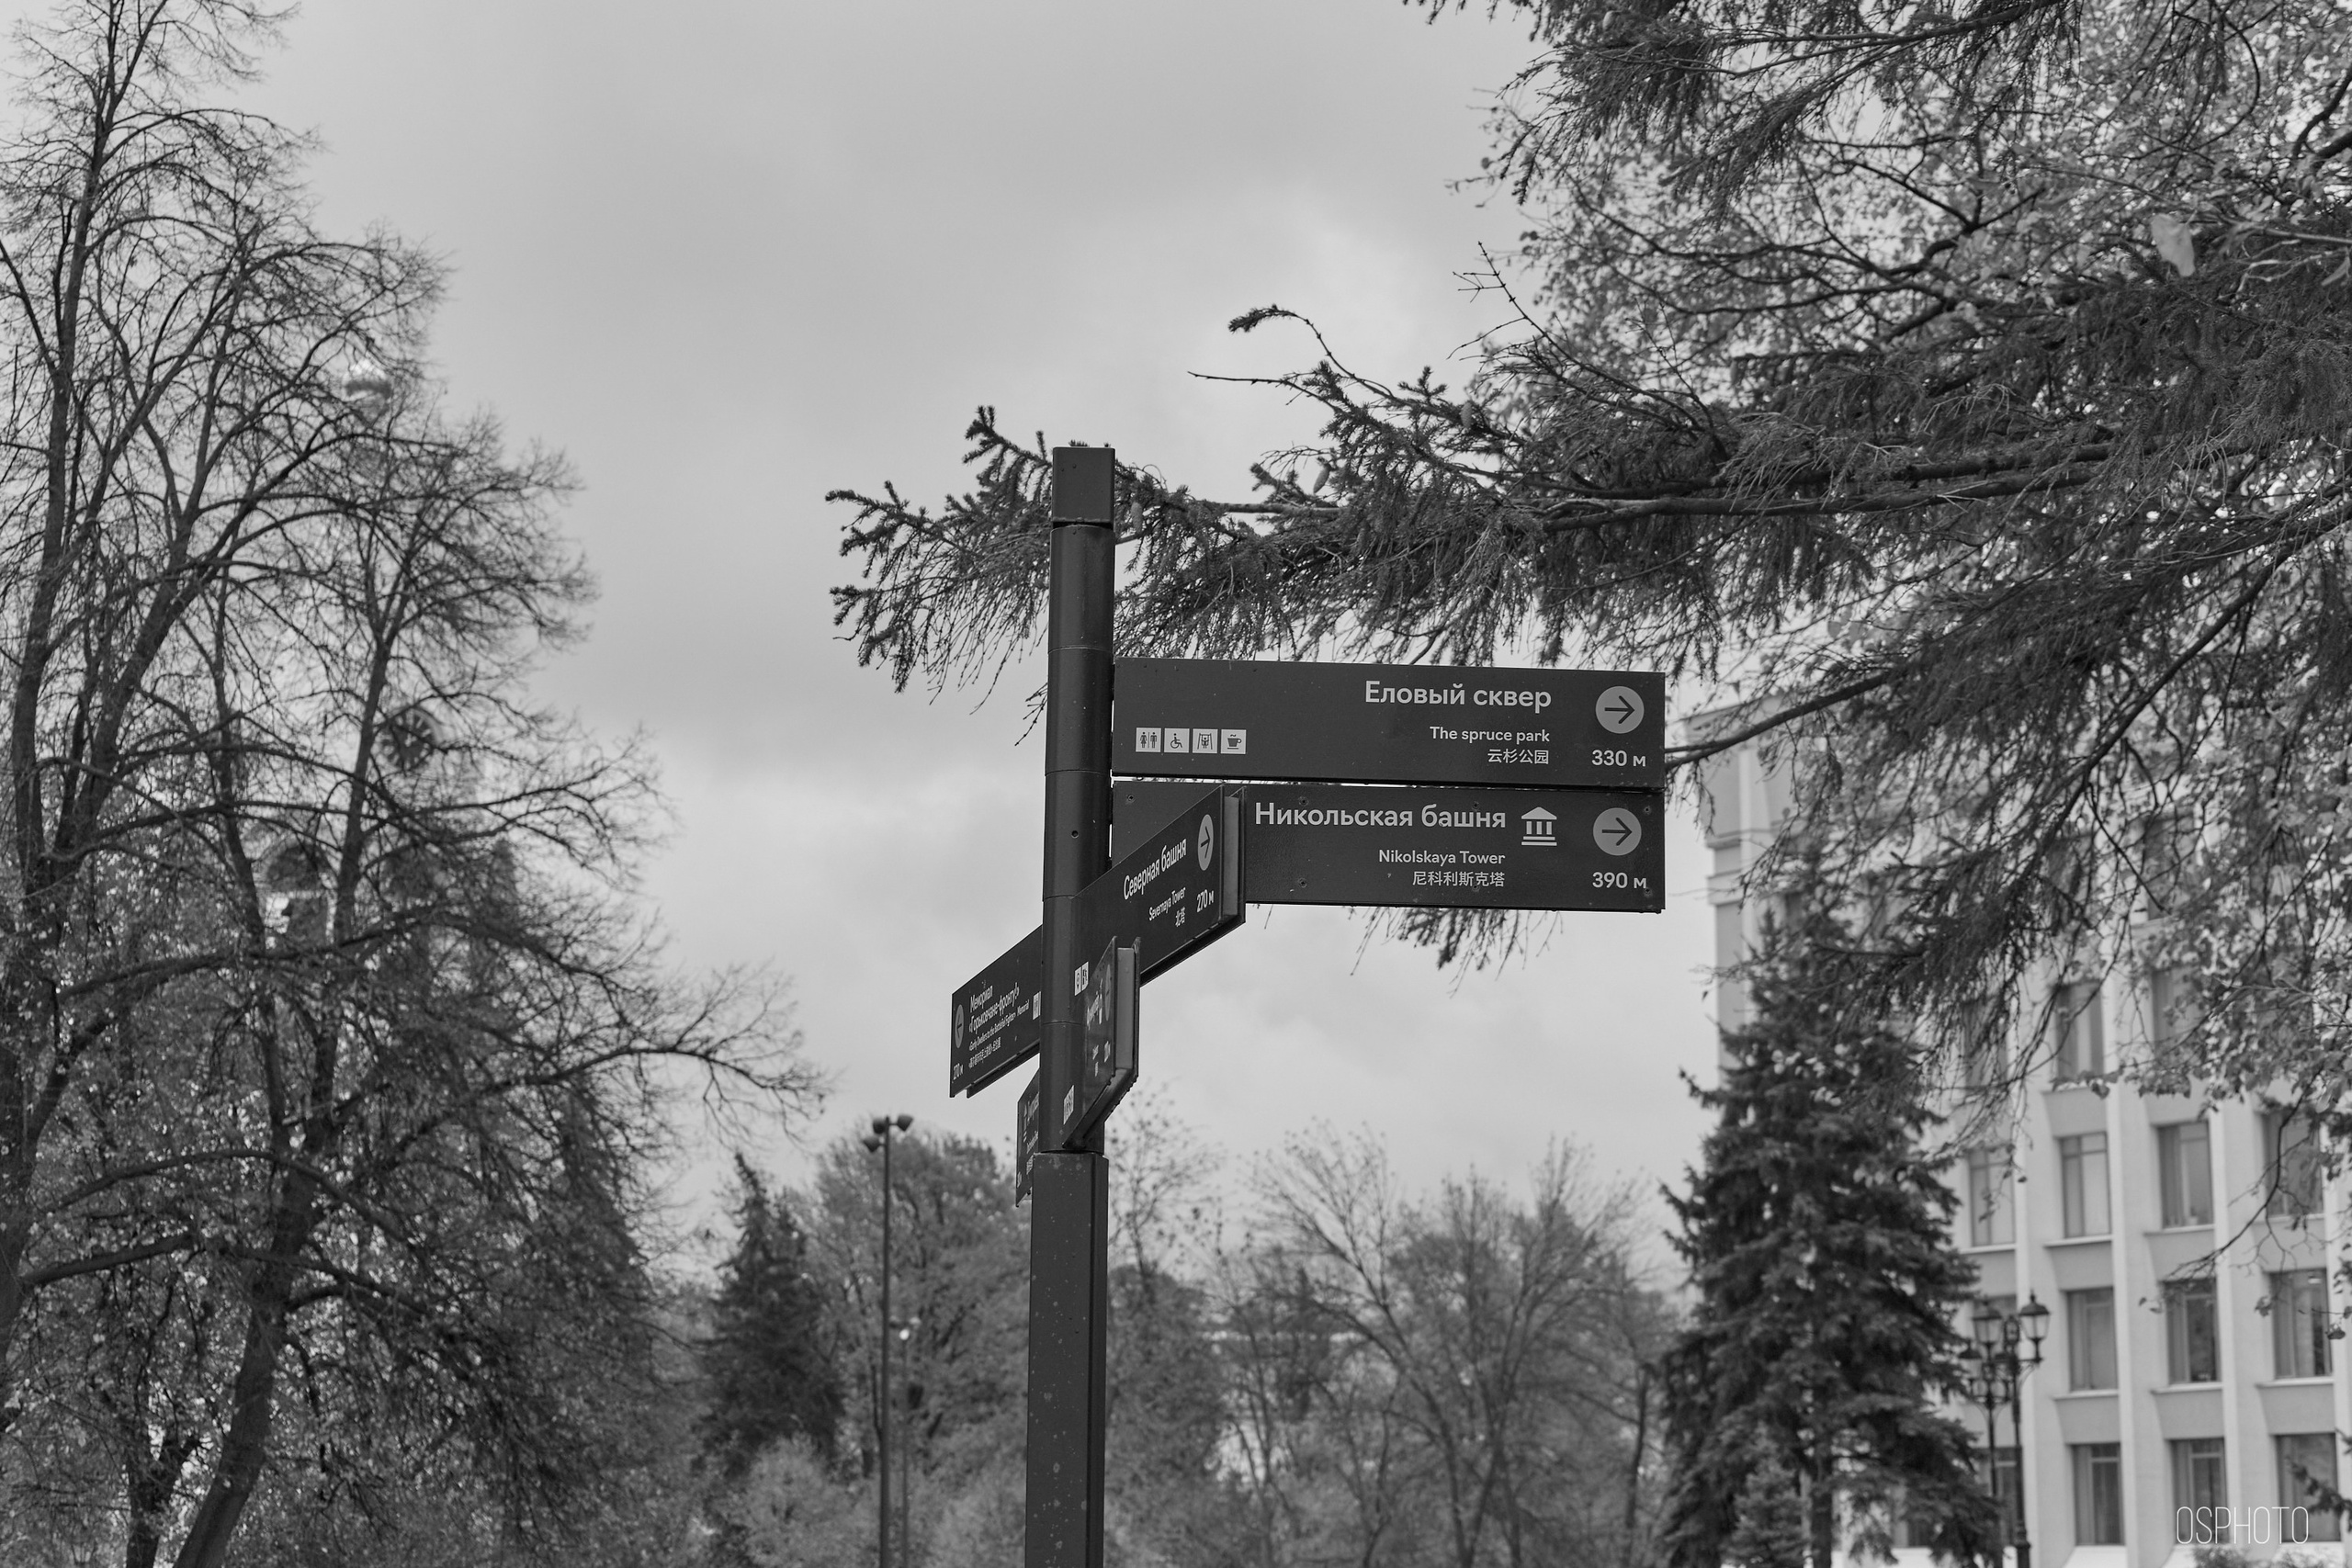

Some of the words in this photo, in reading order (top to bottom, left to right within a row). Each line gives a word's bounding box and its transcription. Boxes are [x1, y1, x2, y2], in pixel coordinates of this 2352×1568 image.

[1365, 680, 1465, 705] Еловый
[1473, 689, 1552, 714] сквер
[1430, 726, 1458, 740] The
[1461, 729, 1512, 744] spruce
[1516, 728, 1550, 745] park
[1487, 748, 1549, 765] 云杉公园
[1591, 749, 1627, 767] 330
[1255, 802, 1413, 827] Никольская
[1421, 804, 1506, 829] башня
[1378, 849, 1456, 867] Nikolskaya
[1459, 850, 1506, 864] Tower
[1123, 859, 1160, 900] Северная
[1160, 838, 1187, 872] башня
[1412, 870, 1505, 887] 尼科利斯克塔
[1592, 871, 1628, 889] 390
[1171, 887, 1186, 905] Tower
[1196, 889, 1208, 913] 270
[970, 985, 993, 1013] Мемориал
